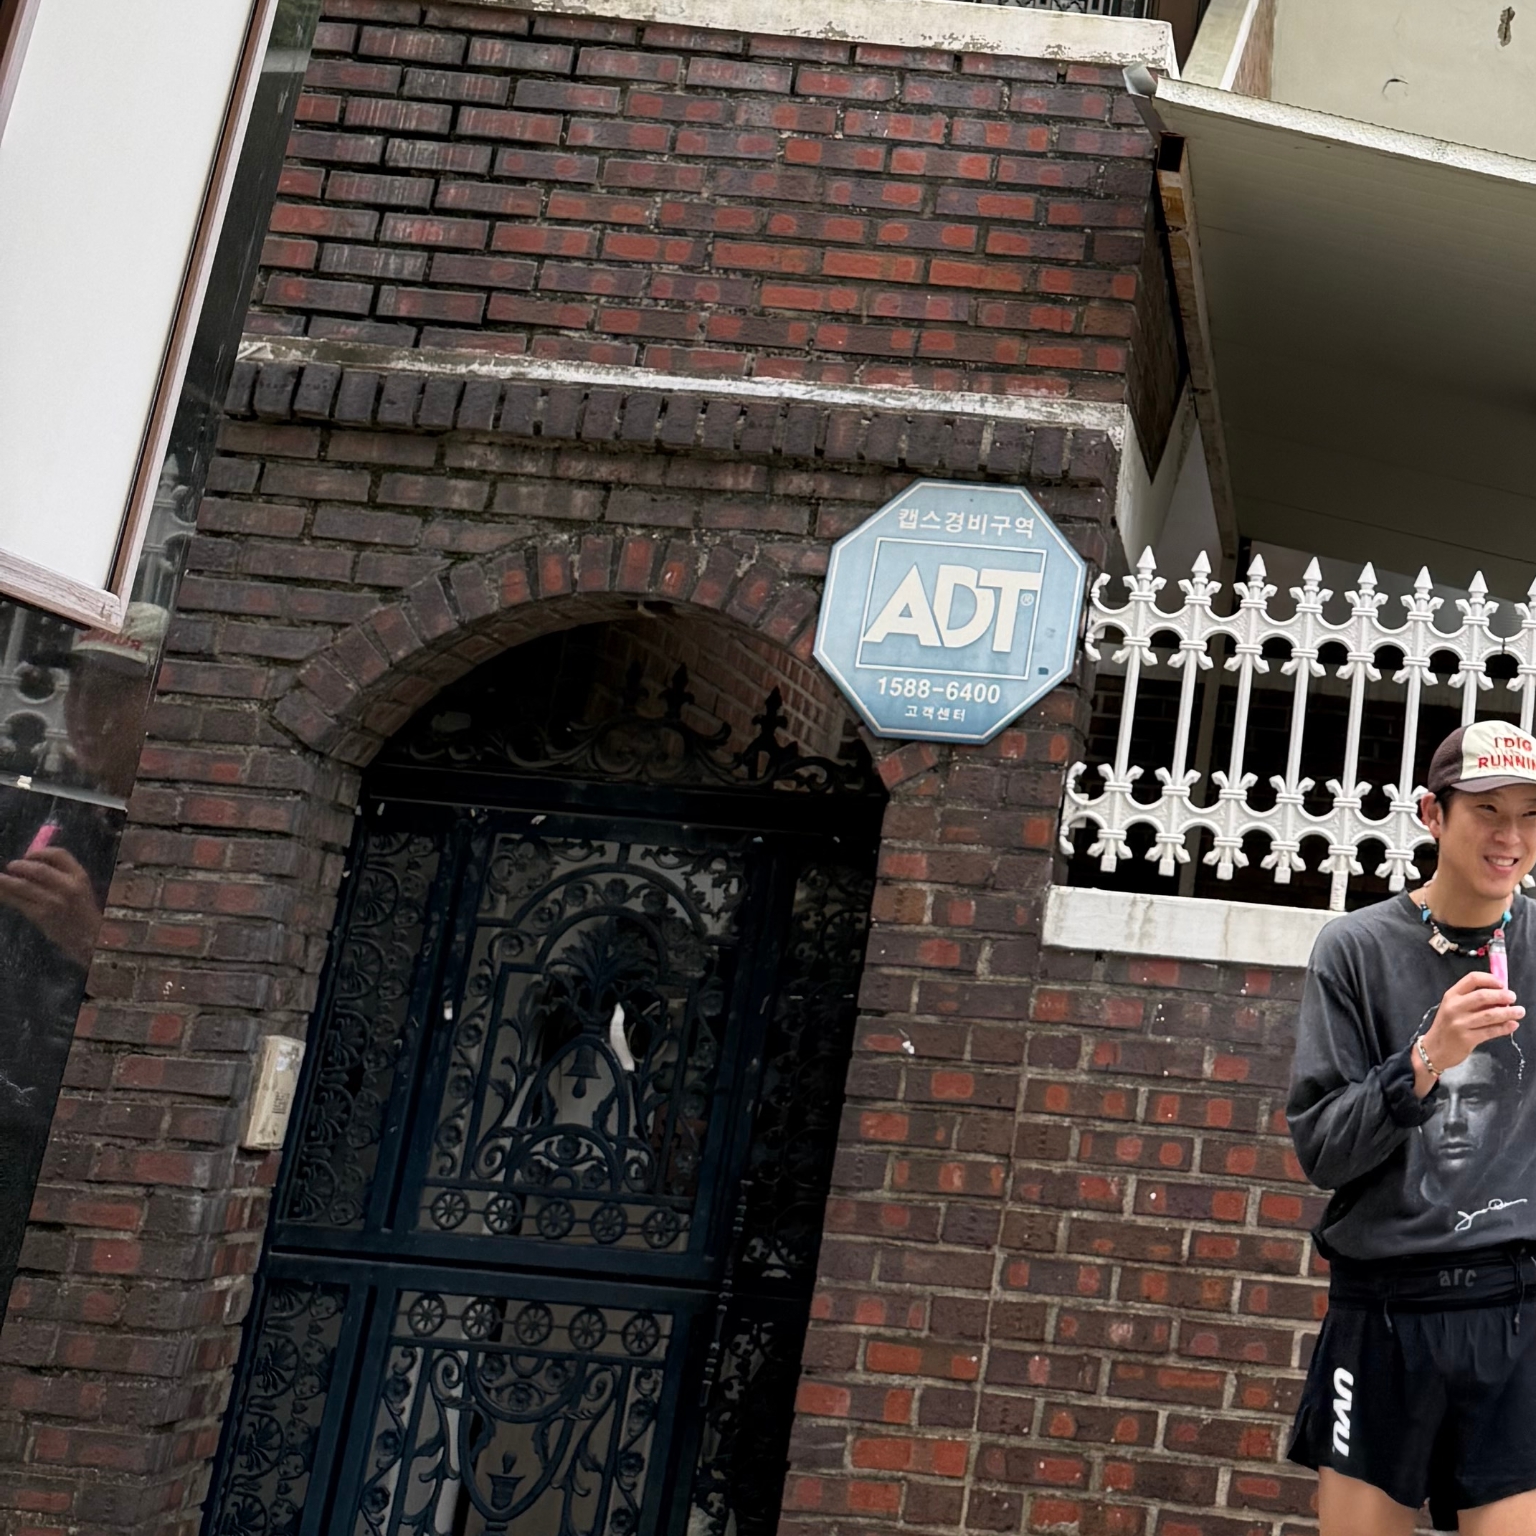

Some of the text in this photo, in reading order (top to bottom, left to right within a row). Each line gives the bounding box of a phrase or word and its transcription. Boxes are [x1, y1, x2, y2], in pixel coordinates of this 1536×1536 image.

[898, 508, 1035, 539] 캡스경비구역
[862, 563, 1043, 653] ADT
[877, 676, 1001, 704] 1588-6400
[1503, 736, 1532, 752] DIG
[1437, 1268, 1477, 1287] arc
